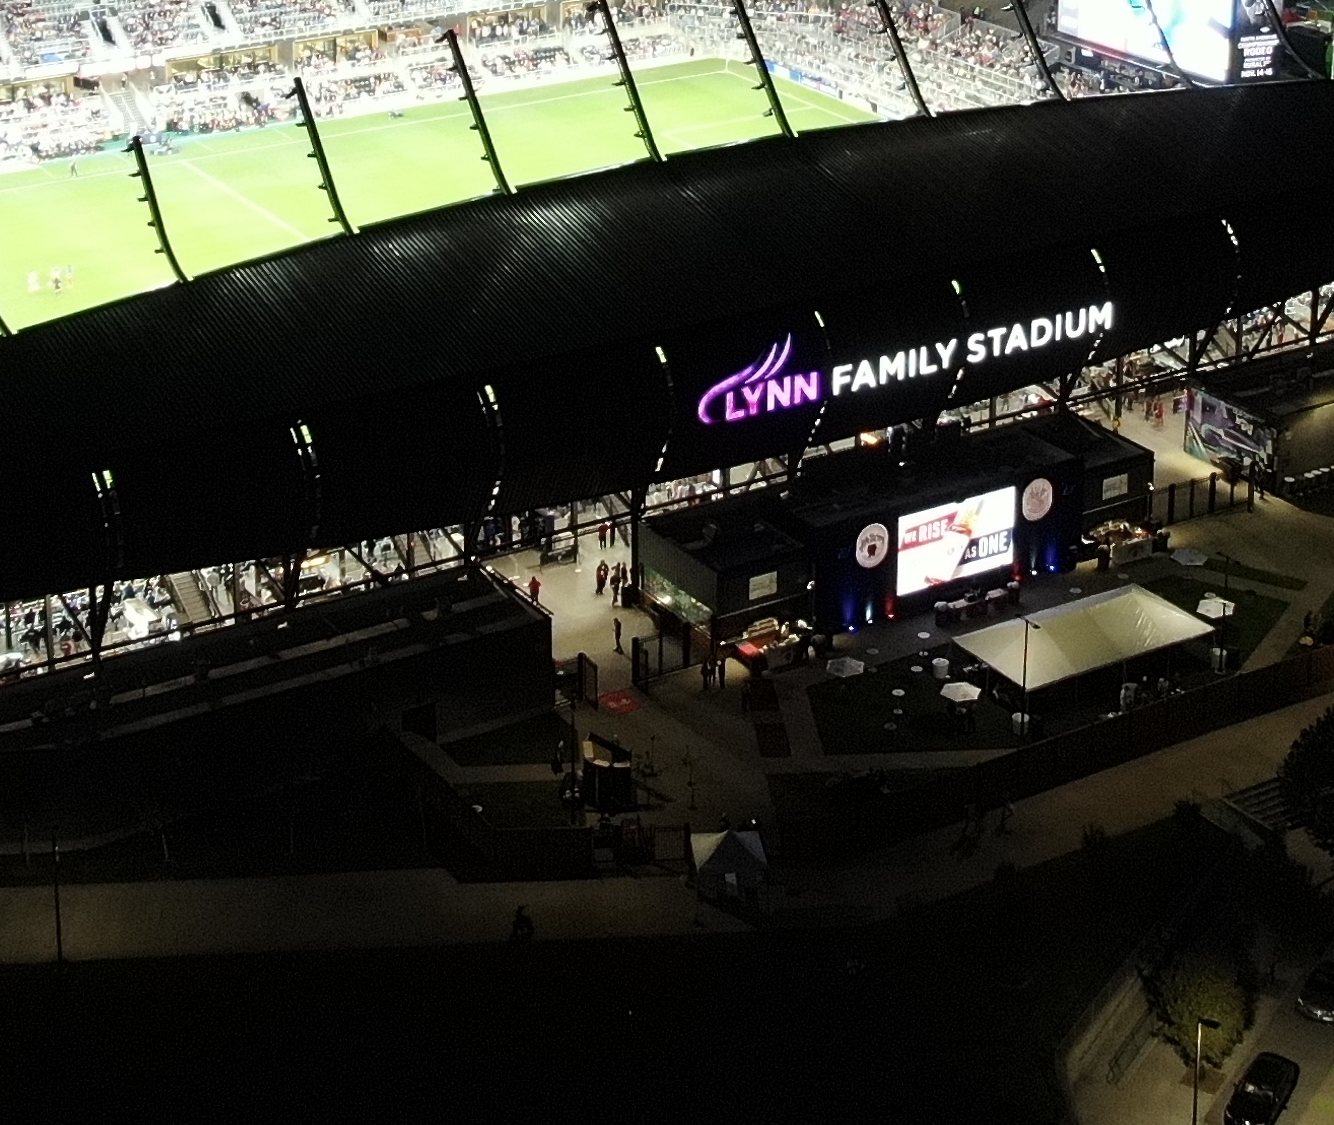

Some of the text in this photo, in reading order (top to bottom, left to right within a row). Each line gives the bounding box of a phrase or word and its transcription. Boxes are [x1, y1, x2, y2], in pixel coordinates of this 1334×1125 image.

[724, 301, 1115, 421] LYNN FAMILY STADIUM
[904, 529, 917, 544] WE
[918, 518, 948, 542] RISE
[964, 530, 1009, 560] AS ONE
